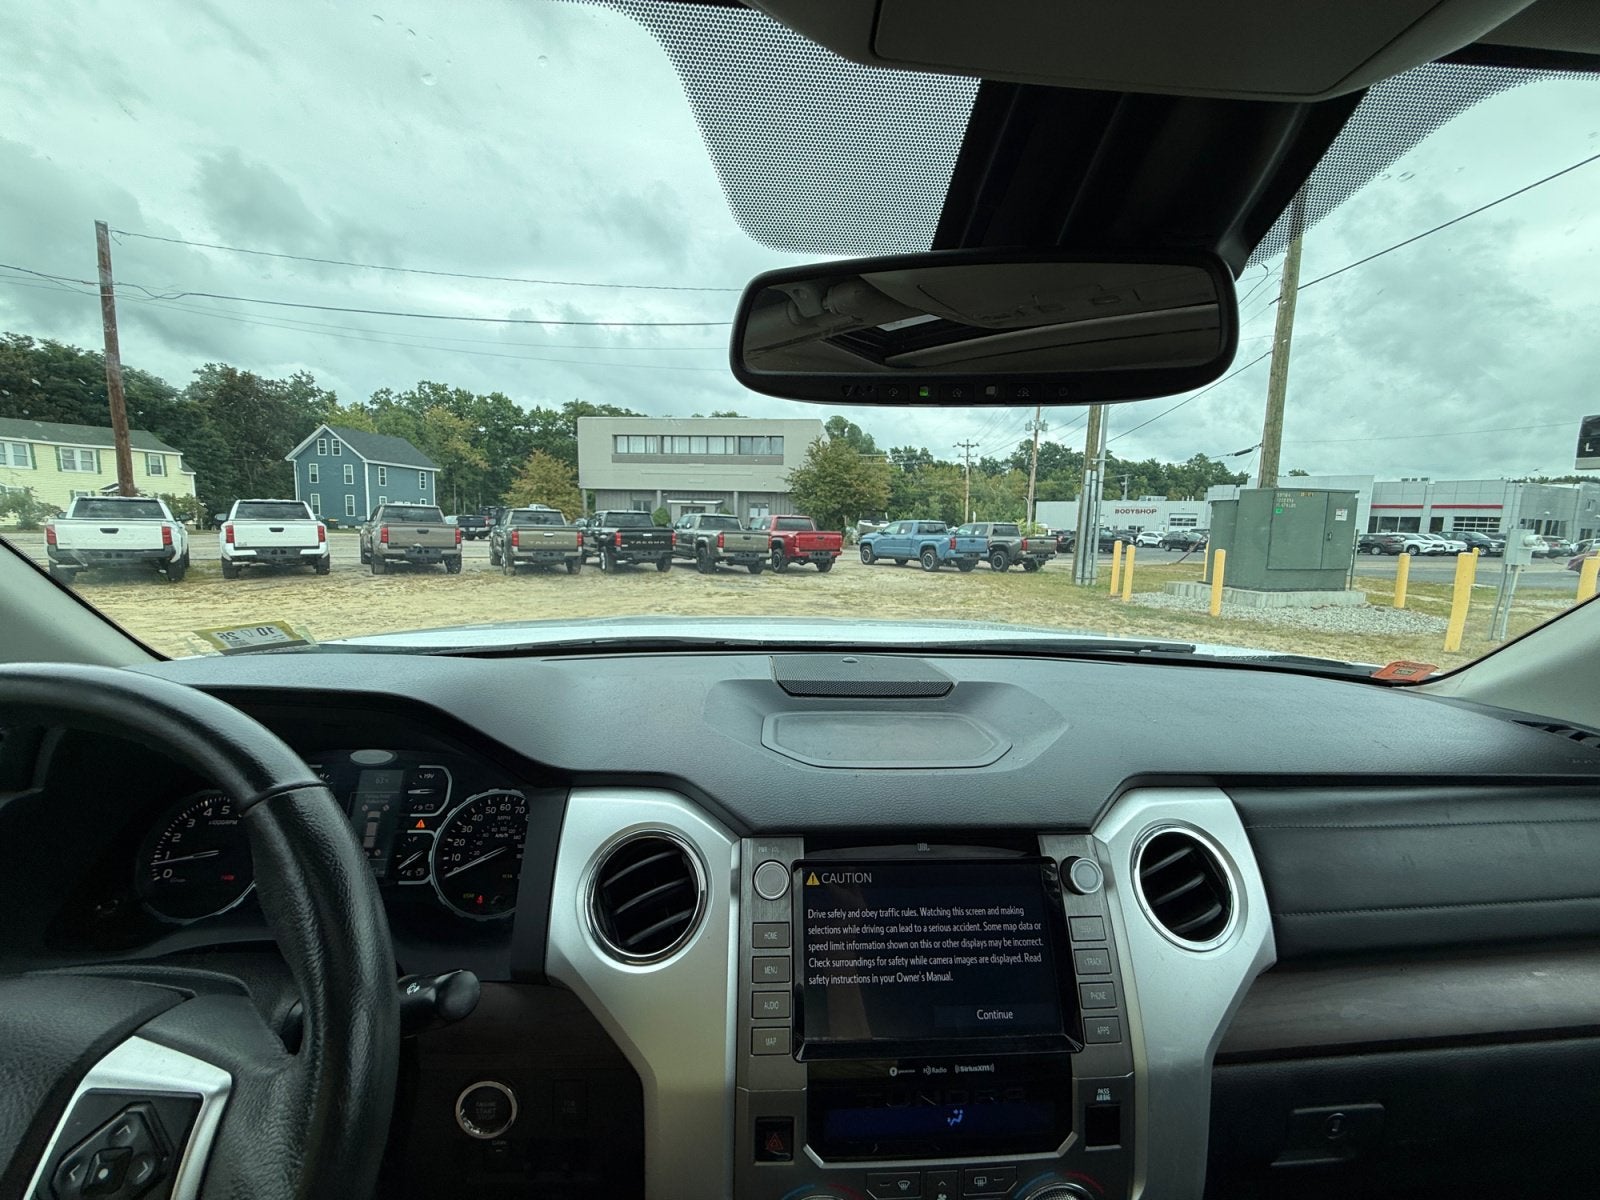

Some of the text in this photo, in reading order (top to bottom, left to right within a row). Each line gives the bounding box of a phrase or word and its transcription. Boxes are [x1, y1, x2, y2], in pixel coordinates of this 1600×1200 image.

[221, 805, 230, 815] 5
[485, 806, 497, 814] 50
[500, 803, 511, 811] 60
[515, 806, 525, 814] 70
[203, 808, 213, 817] 4
[186, 818, 196, 828] 3
[471, 814, 484, 822] 40
[461, 825, 473, 833] 30
[171, 832, 182, 842] 2
[453, 838, 466, 846] 20
[451, 853, 461, 861] 10
[162, 868, 173, 878] 0
[821, 872, 873, 885] CAUTION
[808, 906, 1024, 920] Drive safely and obey traffic rules. Watching this screen and making
[808, 925, 841, 935] selections
[842, 924, 860, 934] while
[861, 924, 884, 935] driving
[899, 923, 913, 933] lead
[914, 924, 922, 933] to
[923, 925, 927, 933] a
[928, 923, 951, 933] serious
[952, 922, 982, 932] accident.
[983, 922, 1002, 932] Some
[1003, 924, 1017, 933] map
[1018, 921, 1033, 931] data
[1034, 923, 1041, 931] or
[808, 938, 1044, 952] speed limit information shown on this or other displays may be incorrect.
[808, 954, 1042, 968] Check surroundings for safety while camera images are displayed. Read
[808, 972, 954, 986] safety instructions in your Owner's Manual.
[764, 1000, 779, 1010] AUDIO
[976, 1009, 1014, 1020] Continue
